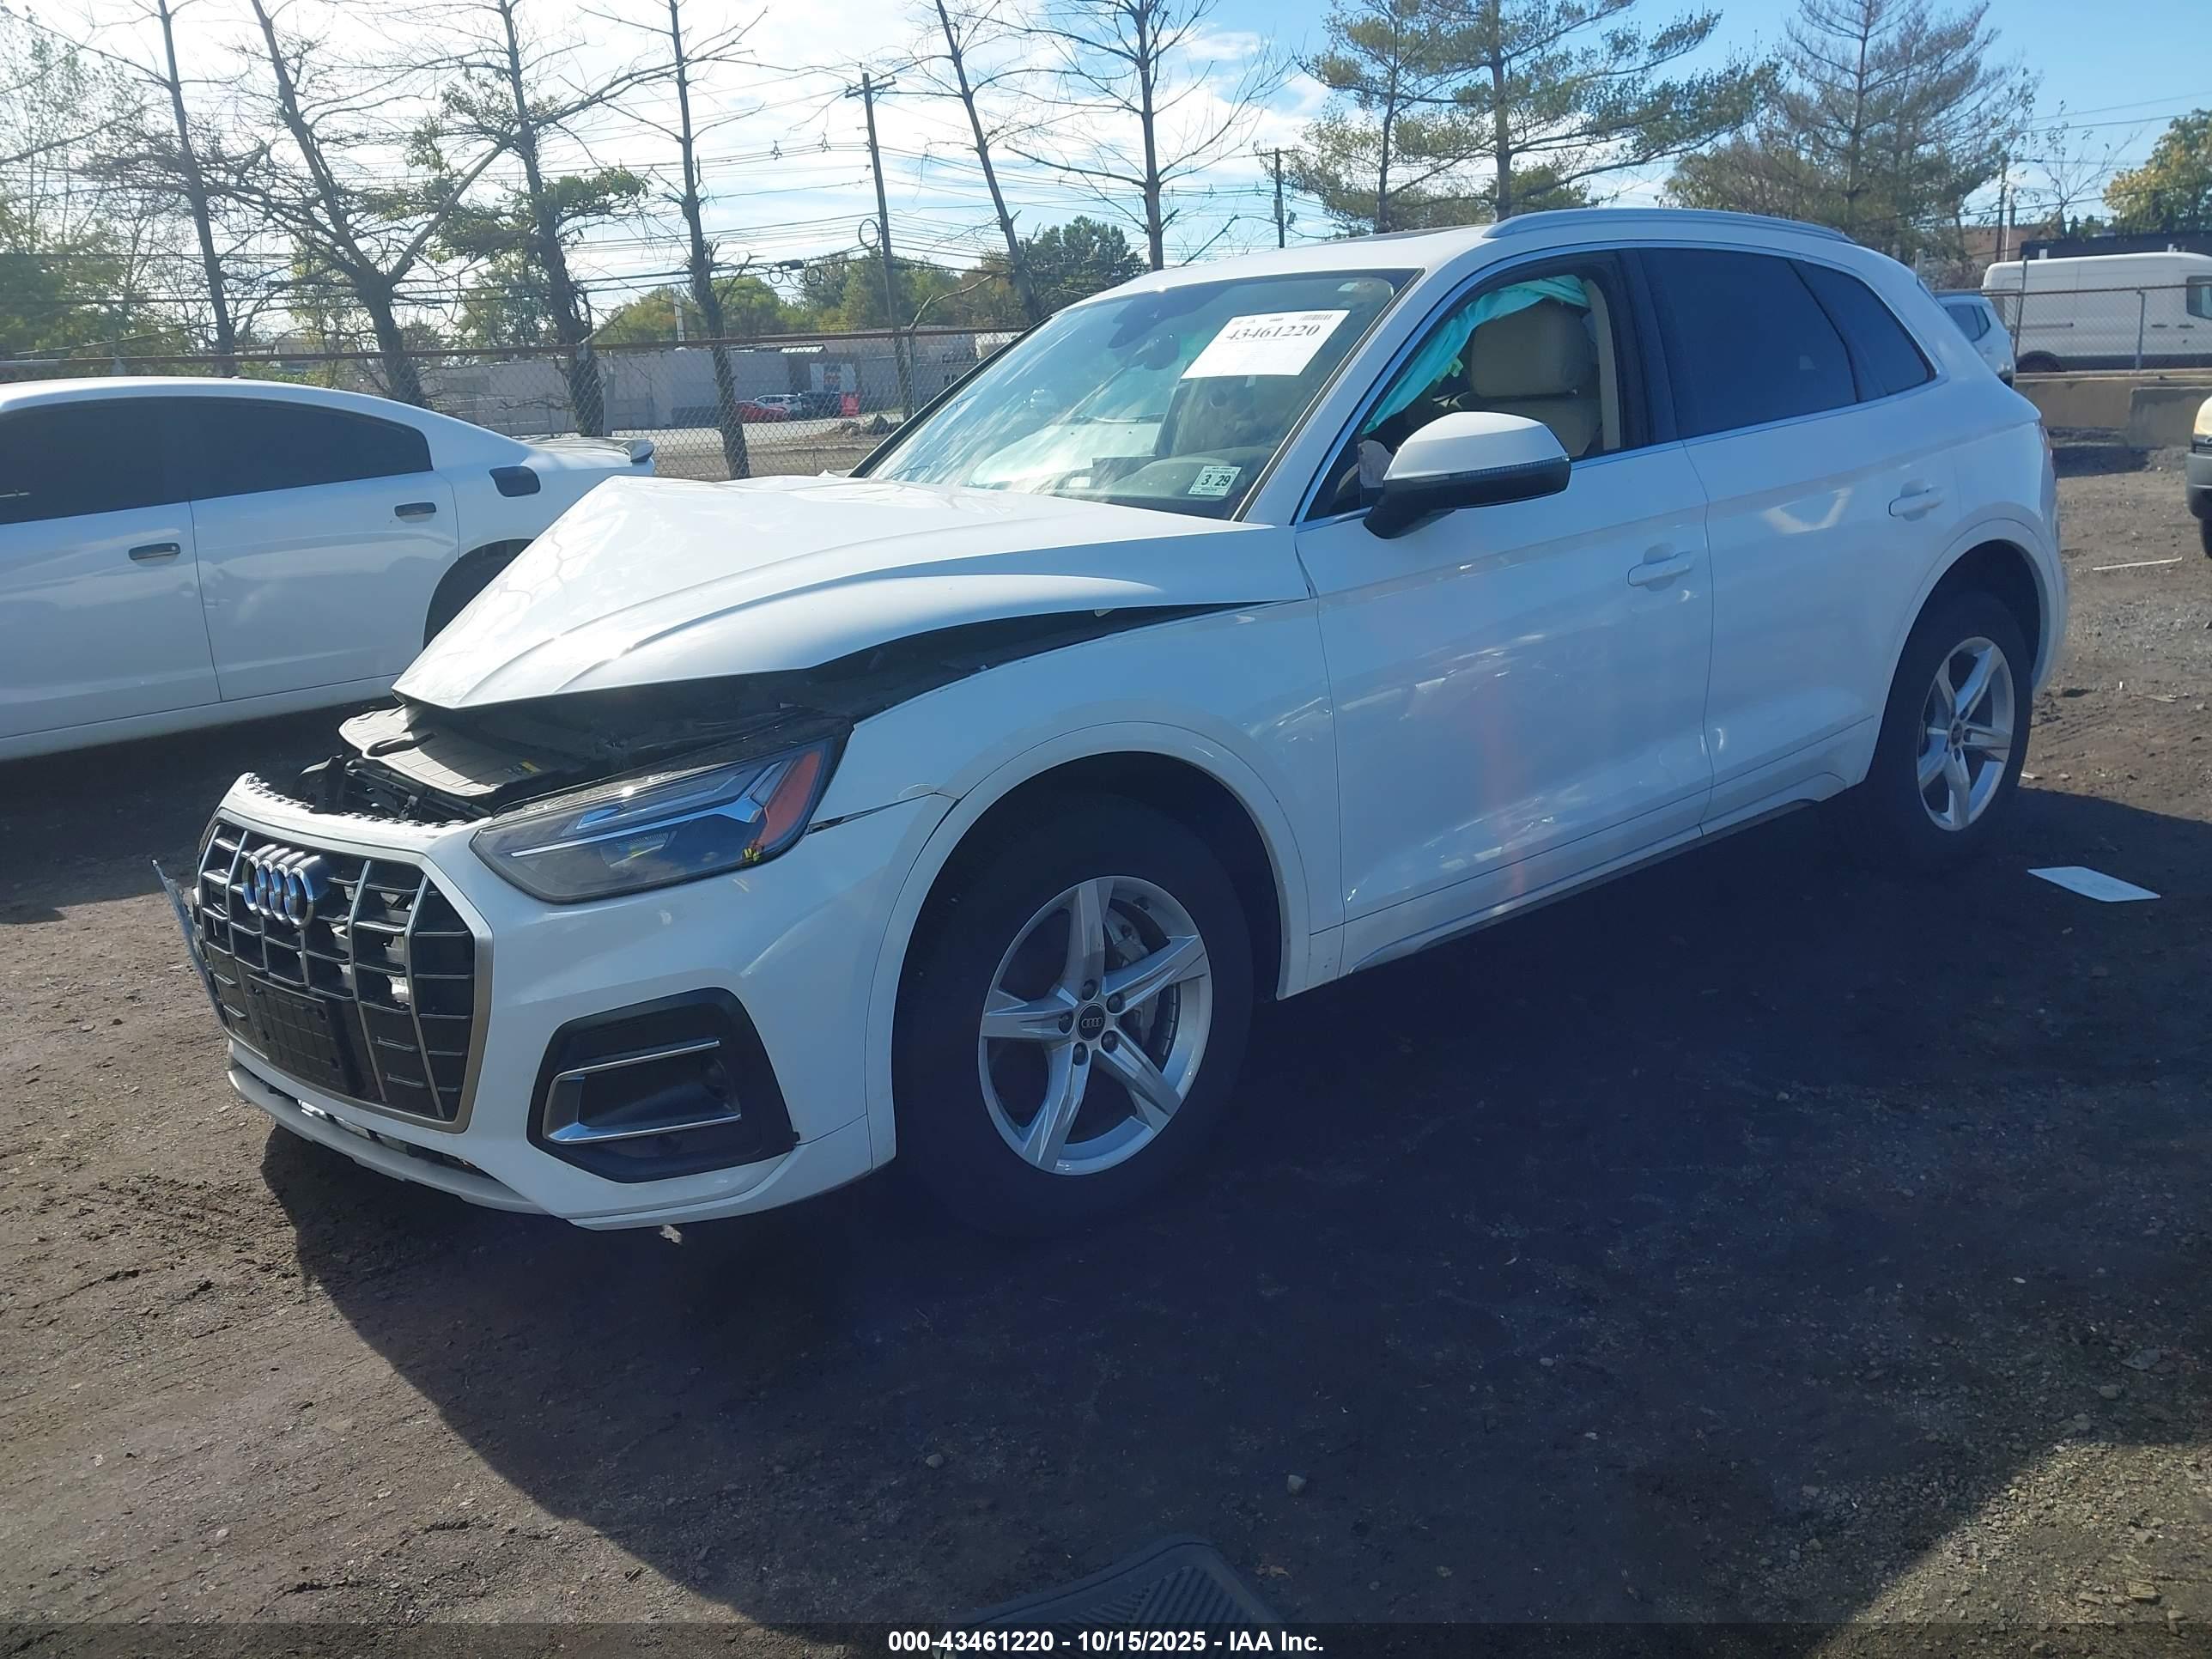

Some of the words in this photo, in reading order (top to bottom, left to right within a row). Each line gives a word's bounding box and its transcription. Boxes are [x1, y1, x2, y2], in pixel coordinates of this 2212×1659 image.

[1225, 324, 1322, 341] 43461220
[1200, 473, 1212, 486] 3
[1213, 474, 1231, 487] 29
